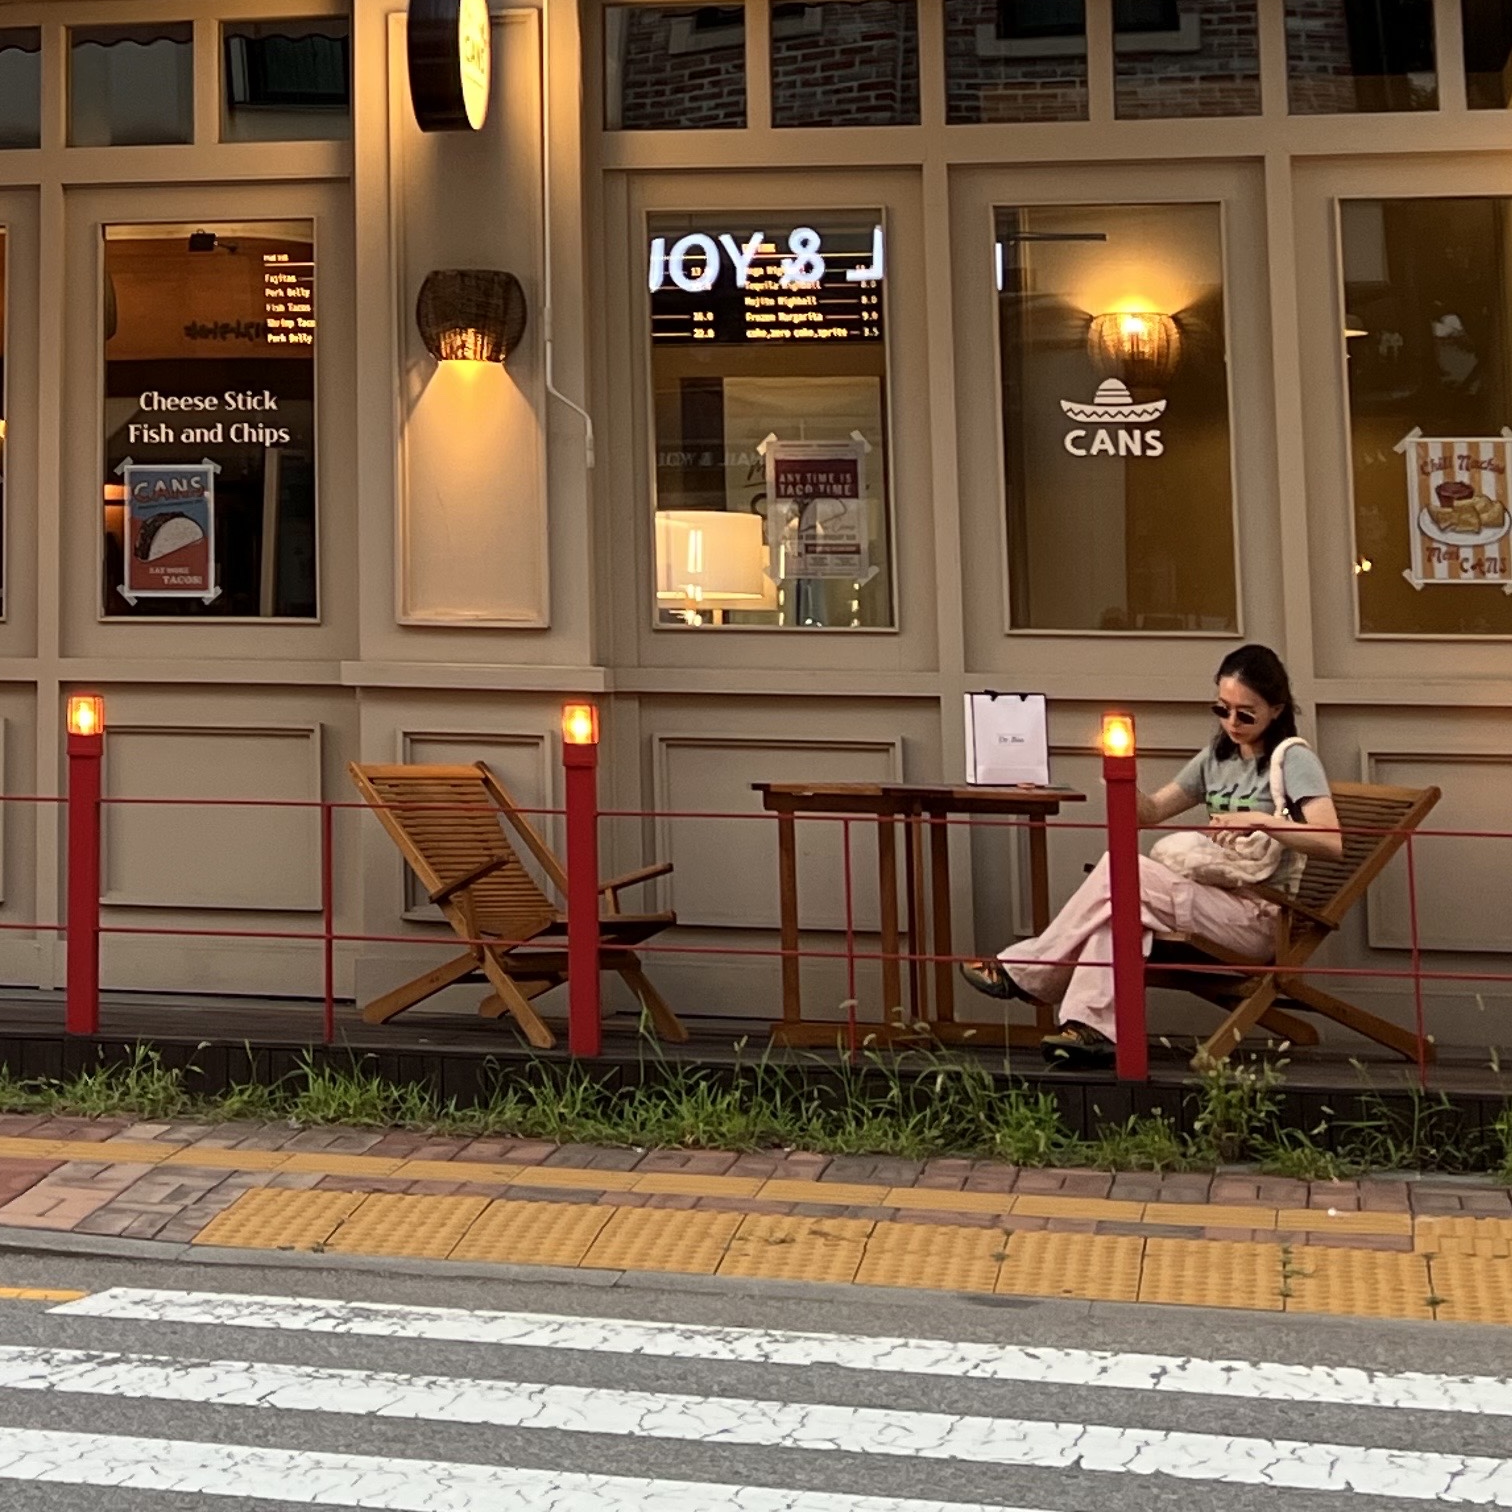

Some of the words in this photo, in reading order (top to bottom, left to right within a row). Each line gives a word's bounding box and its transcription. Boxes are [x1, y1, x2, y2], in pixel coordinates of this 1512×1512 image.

[139, 390, 219, 411] Cheese
[224, 389, 279, 411] Stick
[128, 423, 175, 444] Fish
[180, 422, 224, 444] and
[229, 422, 291, 448] Chips
[1063, 428, 1166, 458] CANS
[133, 475, 206, 503] CANS
[778, 472, 802, 484] ANY
[806, 472, 835, 484] TIME
[839, 472, 853, 484] IS
[778, 483, 814, 496] TACO
[819, 483, 852, 496] TIME
